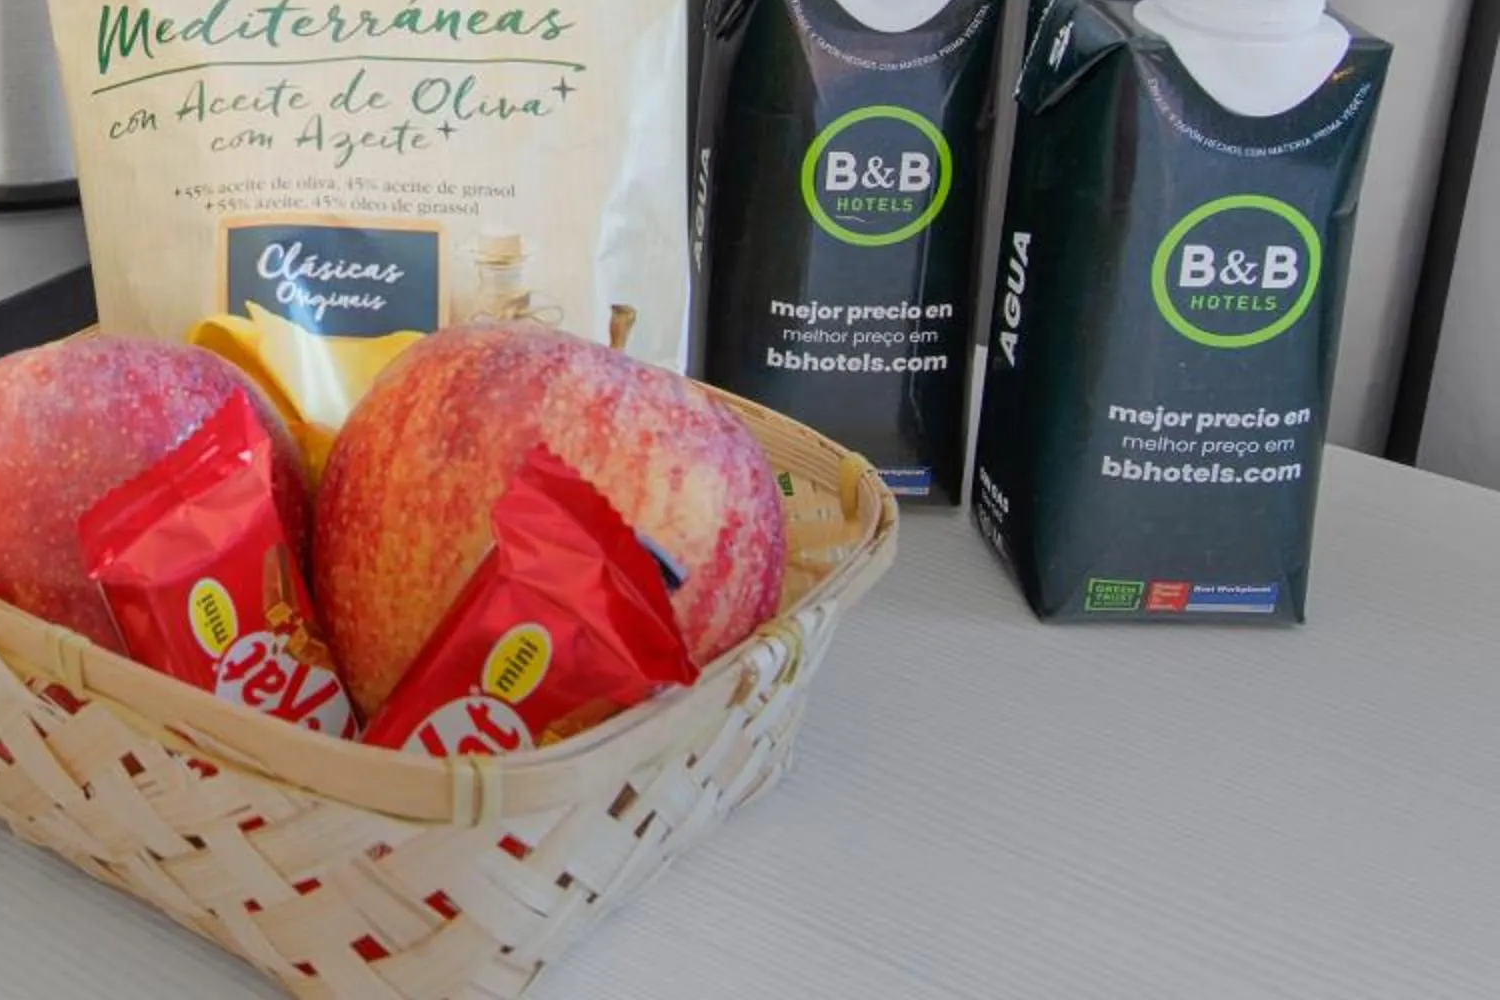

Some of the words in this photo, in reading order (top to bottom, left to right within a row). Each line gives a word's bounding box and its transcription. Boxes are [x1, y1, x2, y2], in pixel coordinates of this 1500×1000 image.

[109, 108, 158, 140] con
[176, 79, 311, 123] Aceite
[329, 67, 392, 114] de
[211, 129, 274, 152] com
[825, 151, 932, 192] B&B
[218, 178, 267, 195] aceite
[271, 176, 290, 191] de
[383, 179, 433, 194] aceite
[437, 179, 458, 195] de
[462, 182, 516, 199] girasol
[392, 198, 414, 214] de
[418, 200, 480, 217] girassol
[836, 197, 913, 213] HOTELS
[257, 241, 405, 284] Clásicas
[1179, 244, 1300, 290] B&B
[276, 280, 389, 323] Originais
[770, 299, 843, 325] mejor
[847, 301, 921, 325] precio
[925, 303, 954, 319] en
[1000, 231, 1032, 368] AGUA
[1190, 295, 1278, 312] HOTELS
[783, 326, 848, 343] melhor
[853, 330, 905, 347] preço
[909, 330, 939, 343] em
[766, 347, 948, 373] bbhotels.com
[1108, 404, 1192, 432] mejor
[1196, 407, 1280, 433] precio
[1284, 408, 1311, 426] en
[1121, 436, 1196, 453] melhor
[1201, 440, 1260, 457] preço
[1264, 438, 1295, 452] em
[1101, 456, 1302, 484] bbhotels.com
[197, 592, 230, 645] mini
[495, 635, 539, 693] mini
